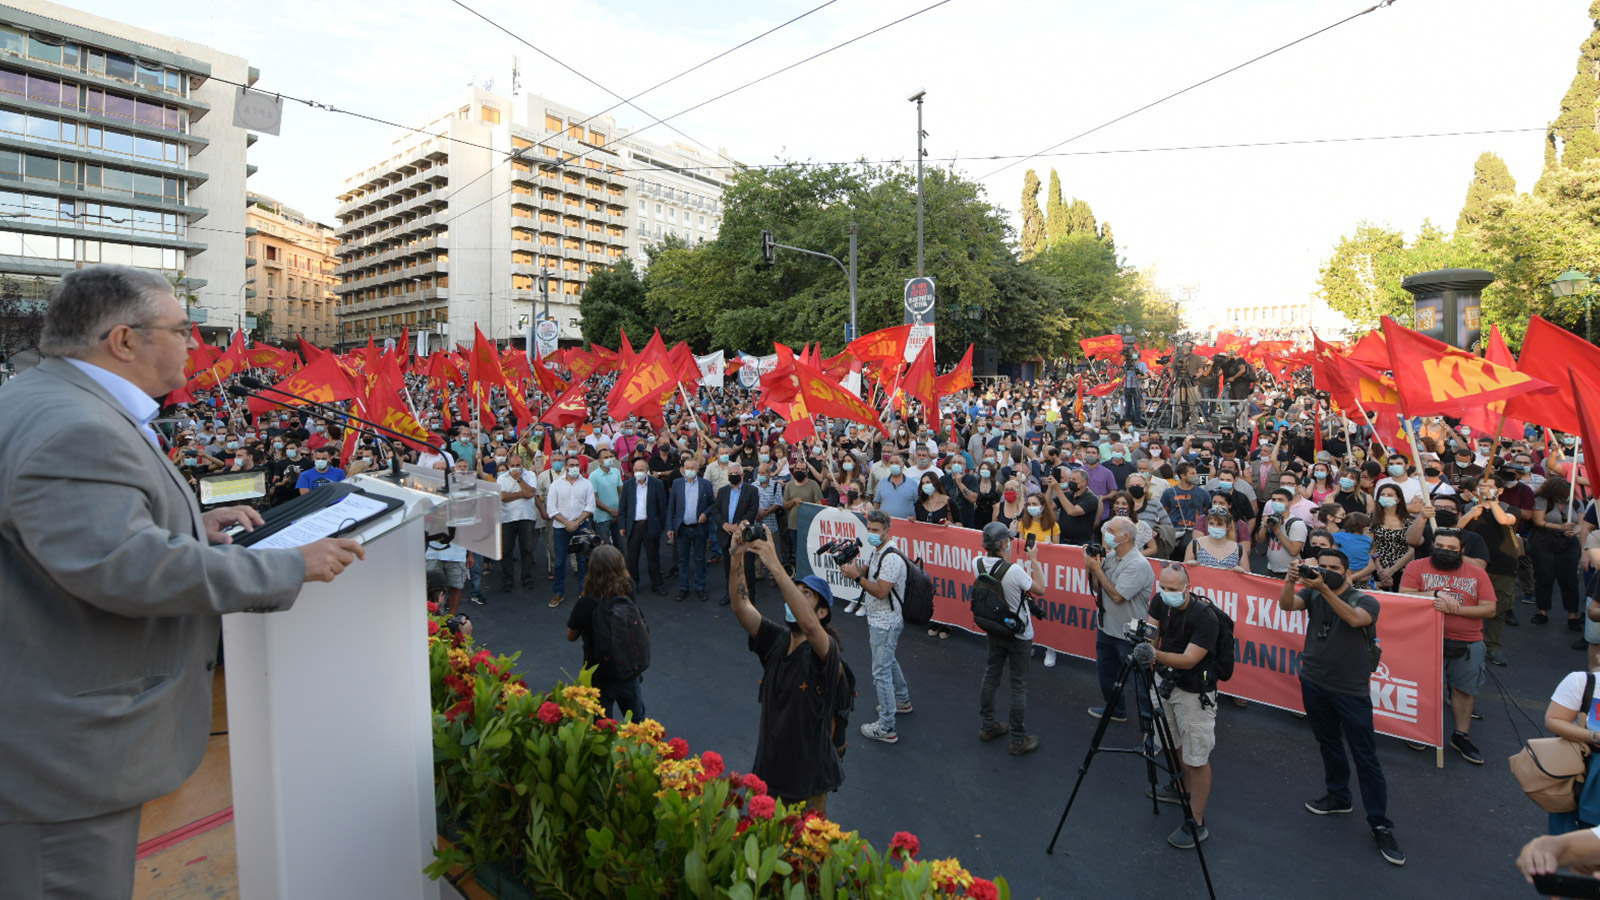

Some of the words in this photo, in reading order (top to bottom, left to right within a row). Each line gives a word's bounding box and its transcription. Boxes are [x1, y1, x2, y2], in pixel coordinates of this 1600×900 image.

[820, 519, 832, 536] ΝΑ
[834, 521, 856, 539] ΜΗΝ
[912, 539, 973, 574] ΜΕΛΛΟΝ
[1245, 594, 1310, 637] ΣΚΛΑ
[1370, 680, 1418, 717] ΚΕ
